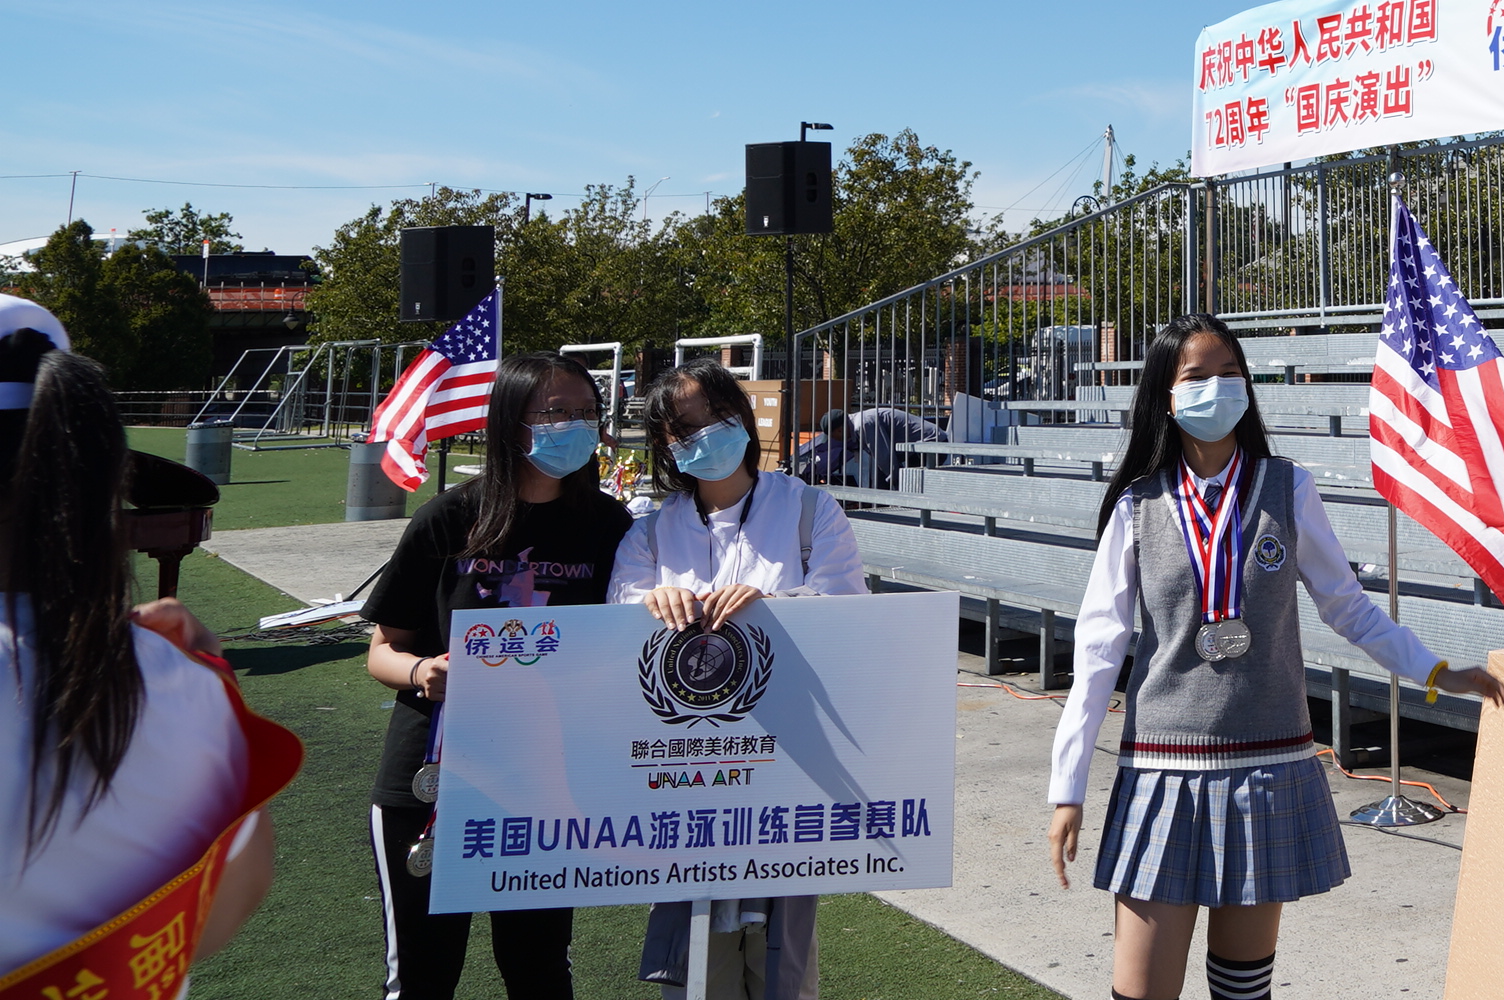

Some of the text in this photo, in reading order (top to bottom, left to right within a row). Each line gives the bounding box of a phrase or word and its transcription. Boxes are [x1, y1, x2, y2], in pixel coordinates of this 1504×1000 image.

[456, 558, 595, 578] WONDERTOWN
[465, 636, 560, 655] 侨运会
[631, 735, 777, 759] 聯合國際美術教育
[648, 768, 754, 789] UNAA ART
[491, 853, 905, 892] United Nations Artists Associates Inc.
